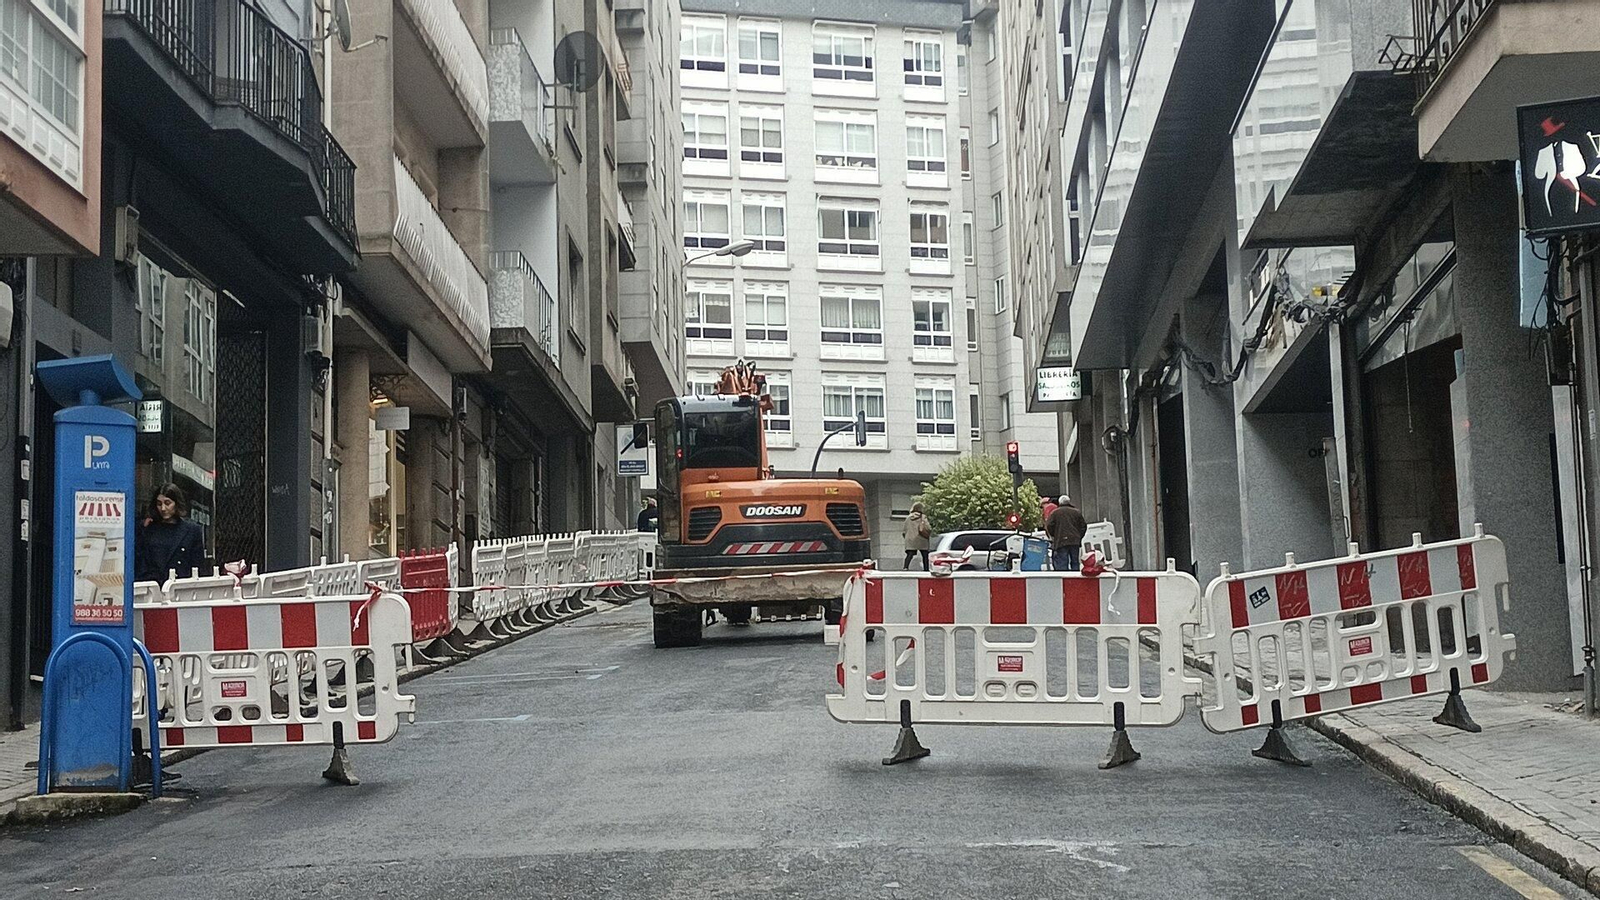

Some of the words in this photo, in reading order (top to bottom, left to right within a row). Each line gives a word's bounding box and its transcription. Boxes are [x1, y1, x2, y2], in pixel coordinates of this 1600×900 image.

[746, 506, 802, 517] DOOSAN
[75, 608, 90, 617] 988
[102, 609, 112, 618] 50
[113, 609, 123, 617] 50
